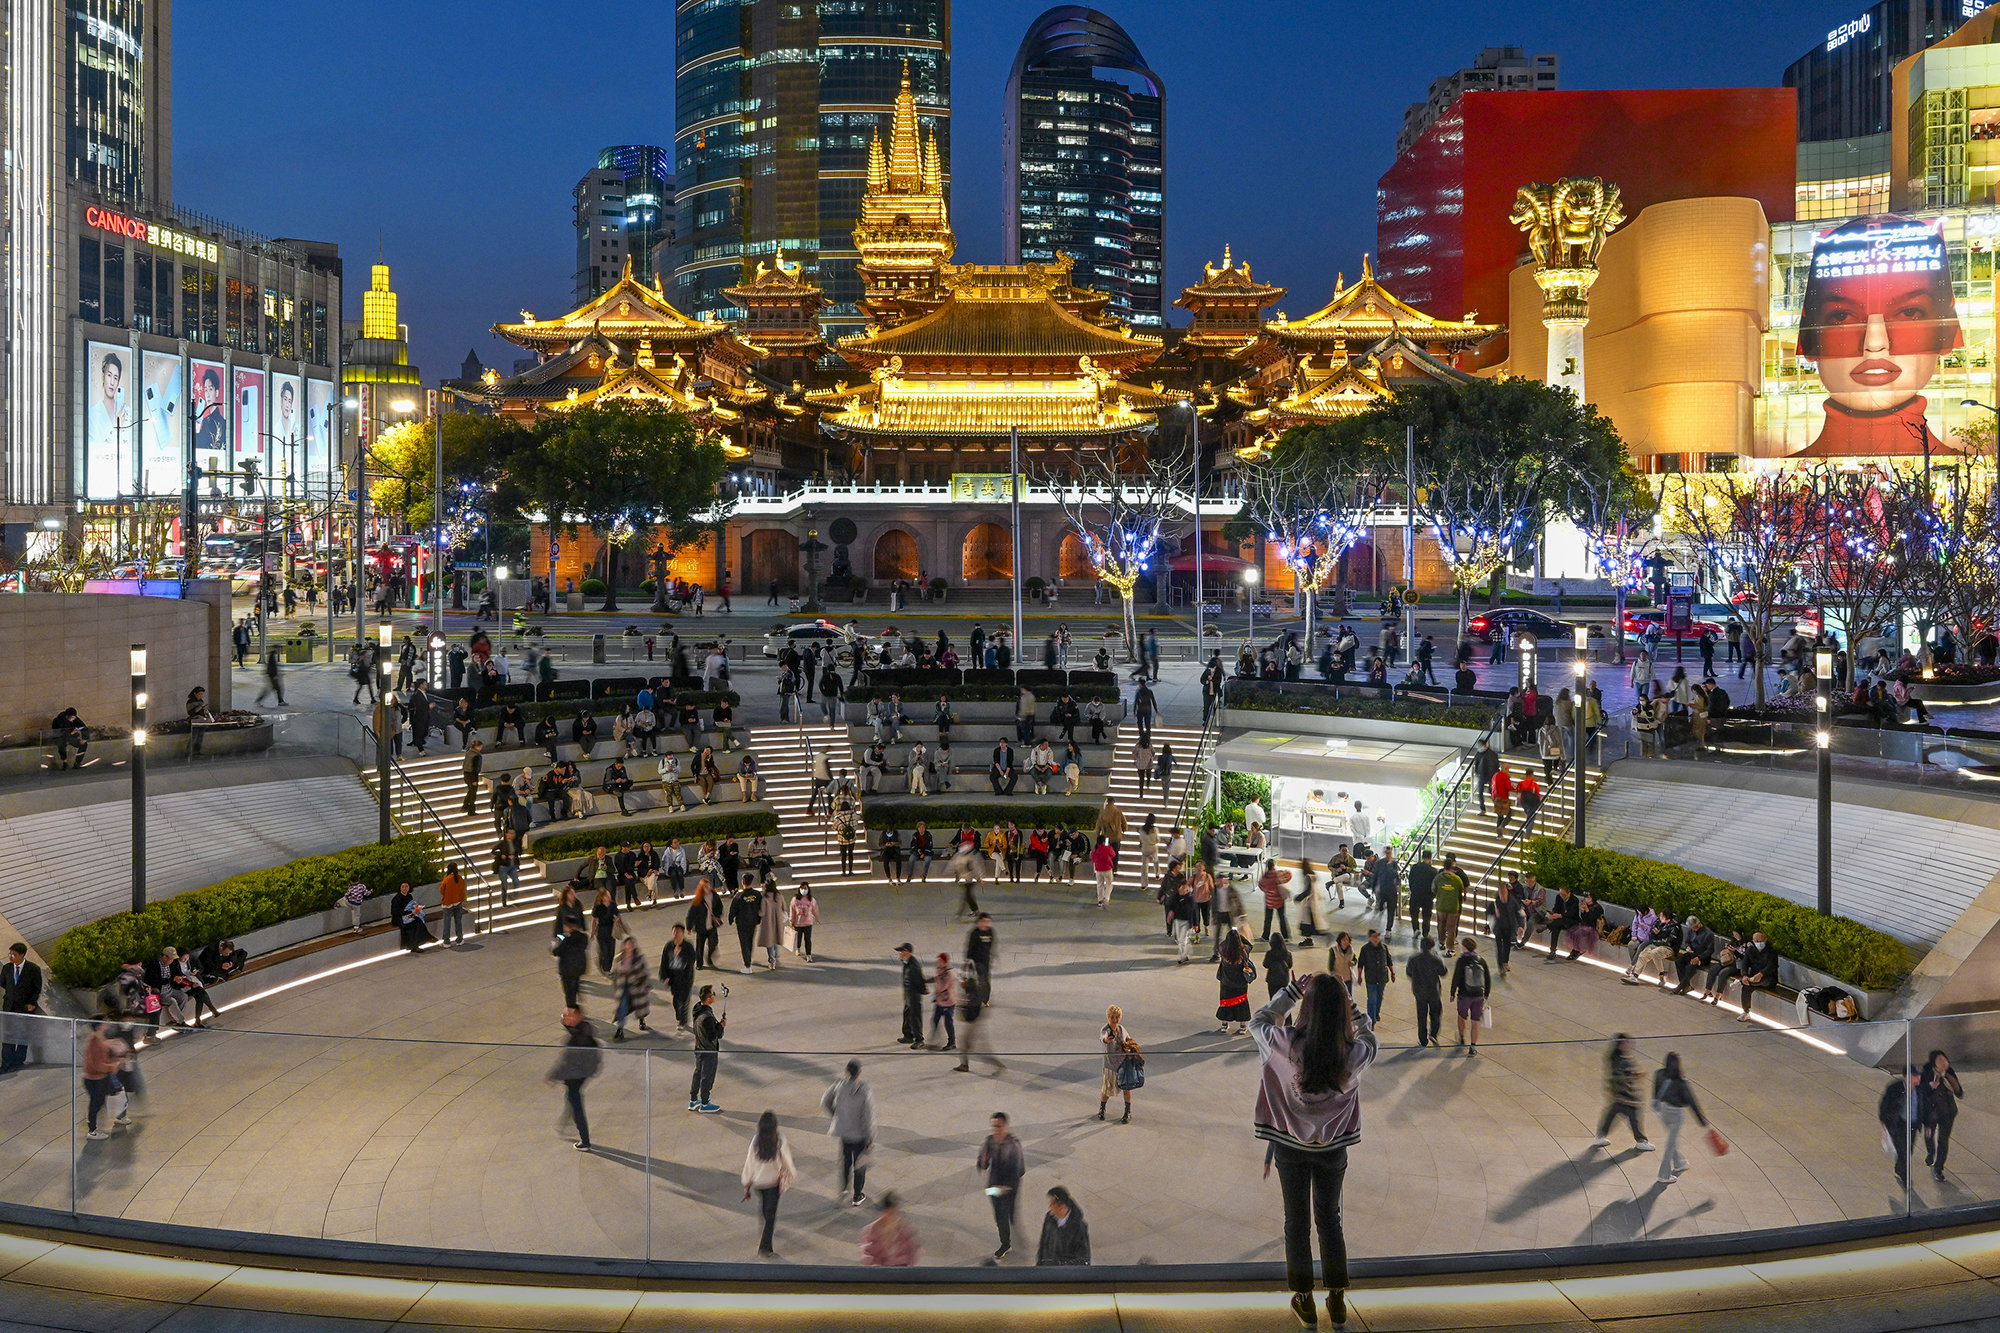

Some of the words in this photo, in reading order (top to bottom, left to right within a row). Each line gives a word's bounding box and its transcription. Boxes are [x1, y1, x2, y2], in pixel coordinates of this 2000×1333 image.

[1827, 13, 1870, 51] 晶品中心
[86, 206, 147, 241] CANNOR
[147, 225, 217, 263] 凯纳咨询集团
